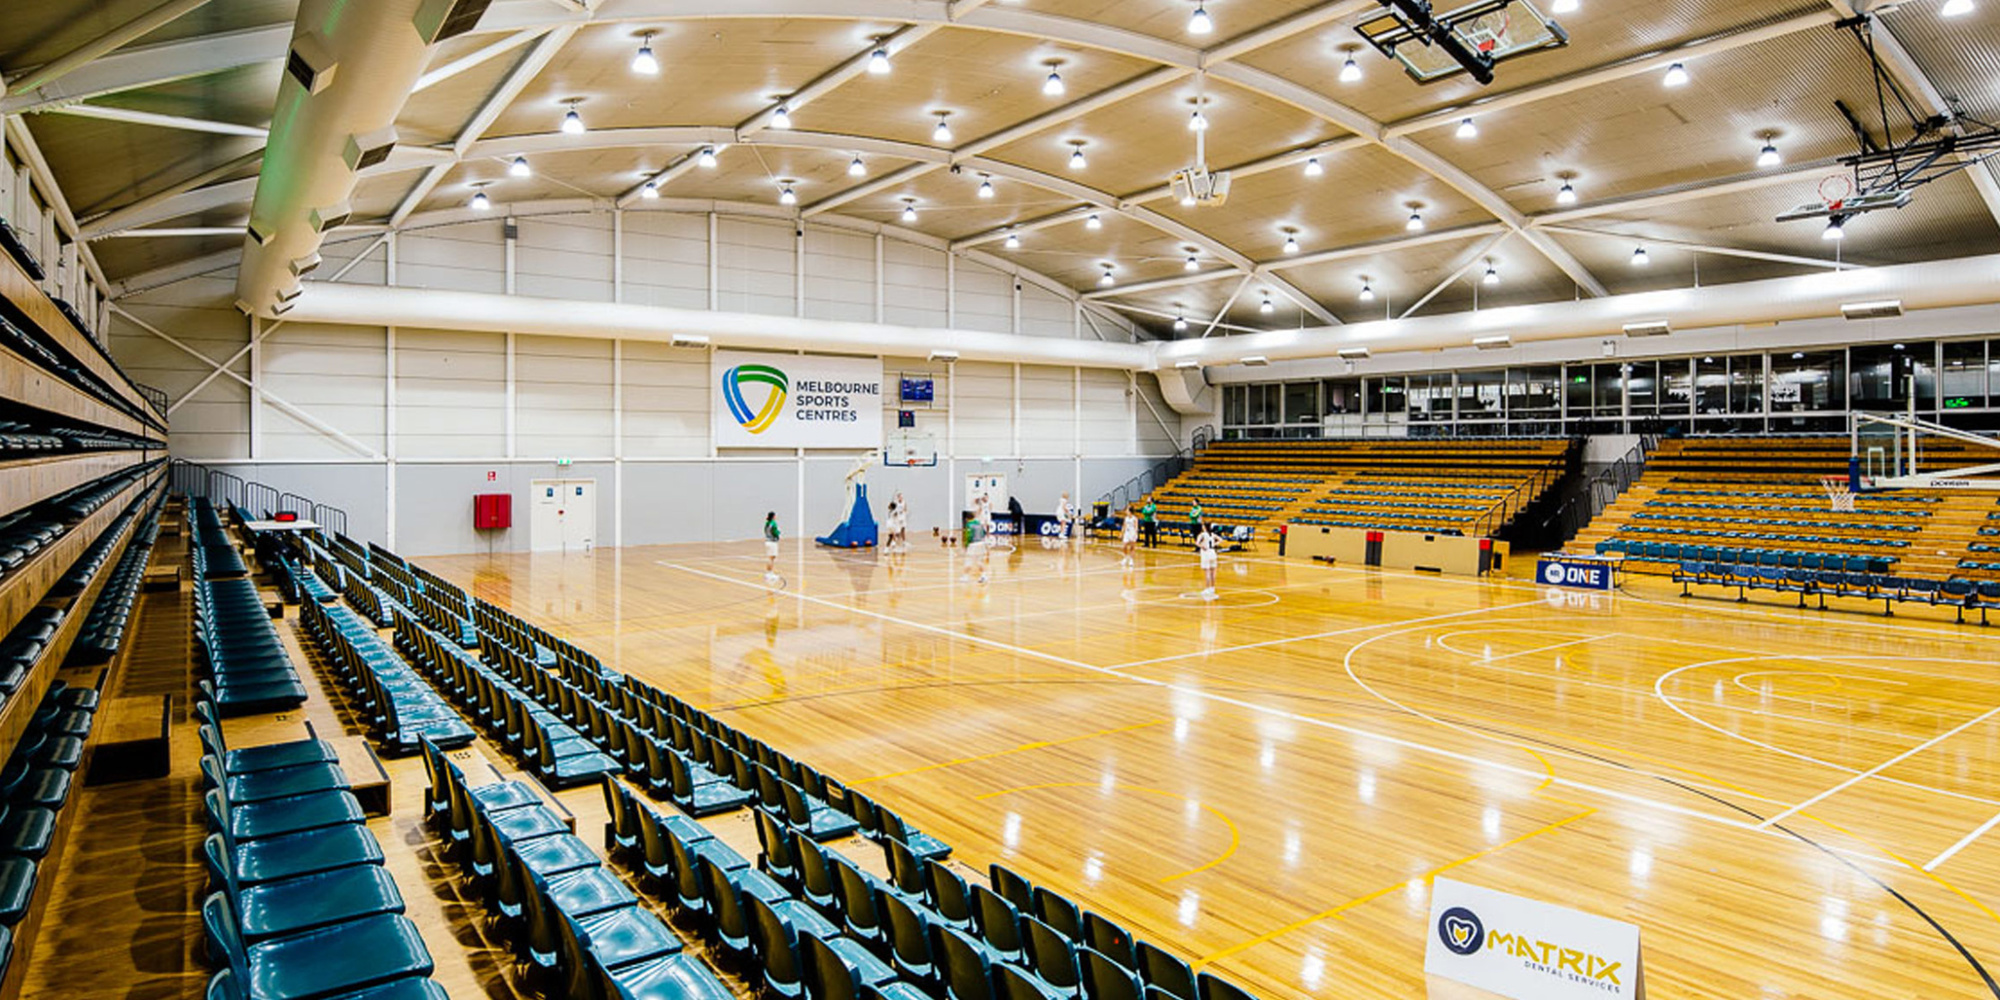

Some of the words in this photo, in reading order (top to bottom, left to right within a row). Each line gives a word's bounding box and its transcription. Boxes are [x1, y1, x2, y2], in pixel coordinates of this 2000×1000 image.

[796, 381, 879, 395] MELBOURNE
[796, 395, 849, 407] SPORTS
[796, 409, 857, 422] CENTRES
[1567, 567, 1600, 585] ONE
[1487, 929, 1621, 985] MATRIX
[1524, 961, 1563, 978] DENTAL
[1568, 973, 1620, 994] SERVICES
